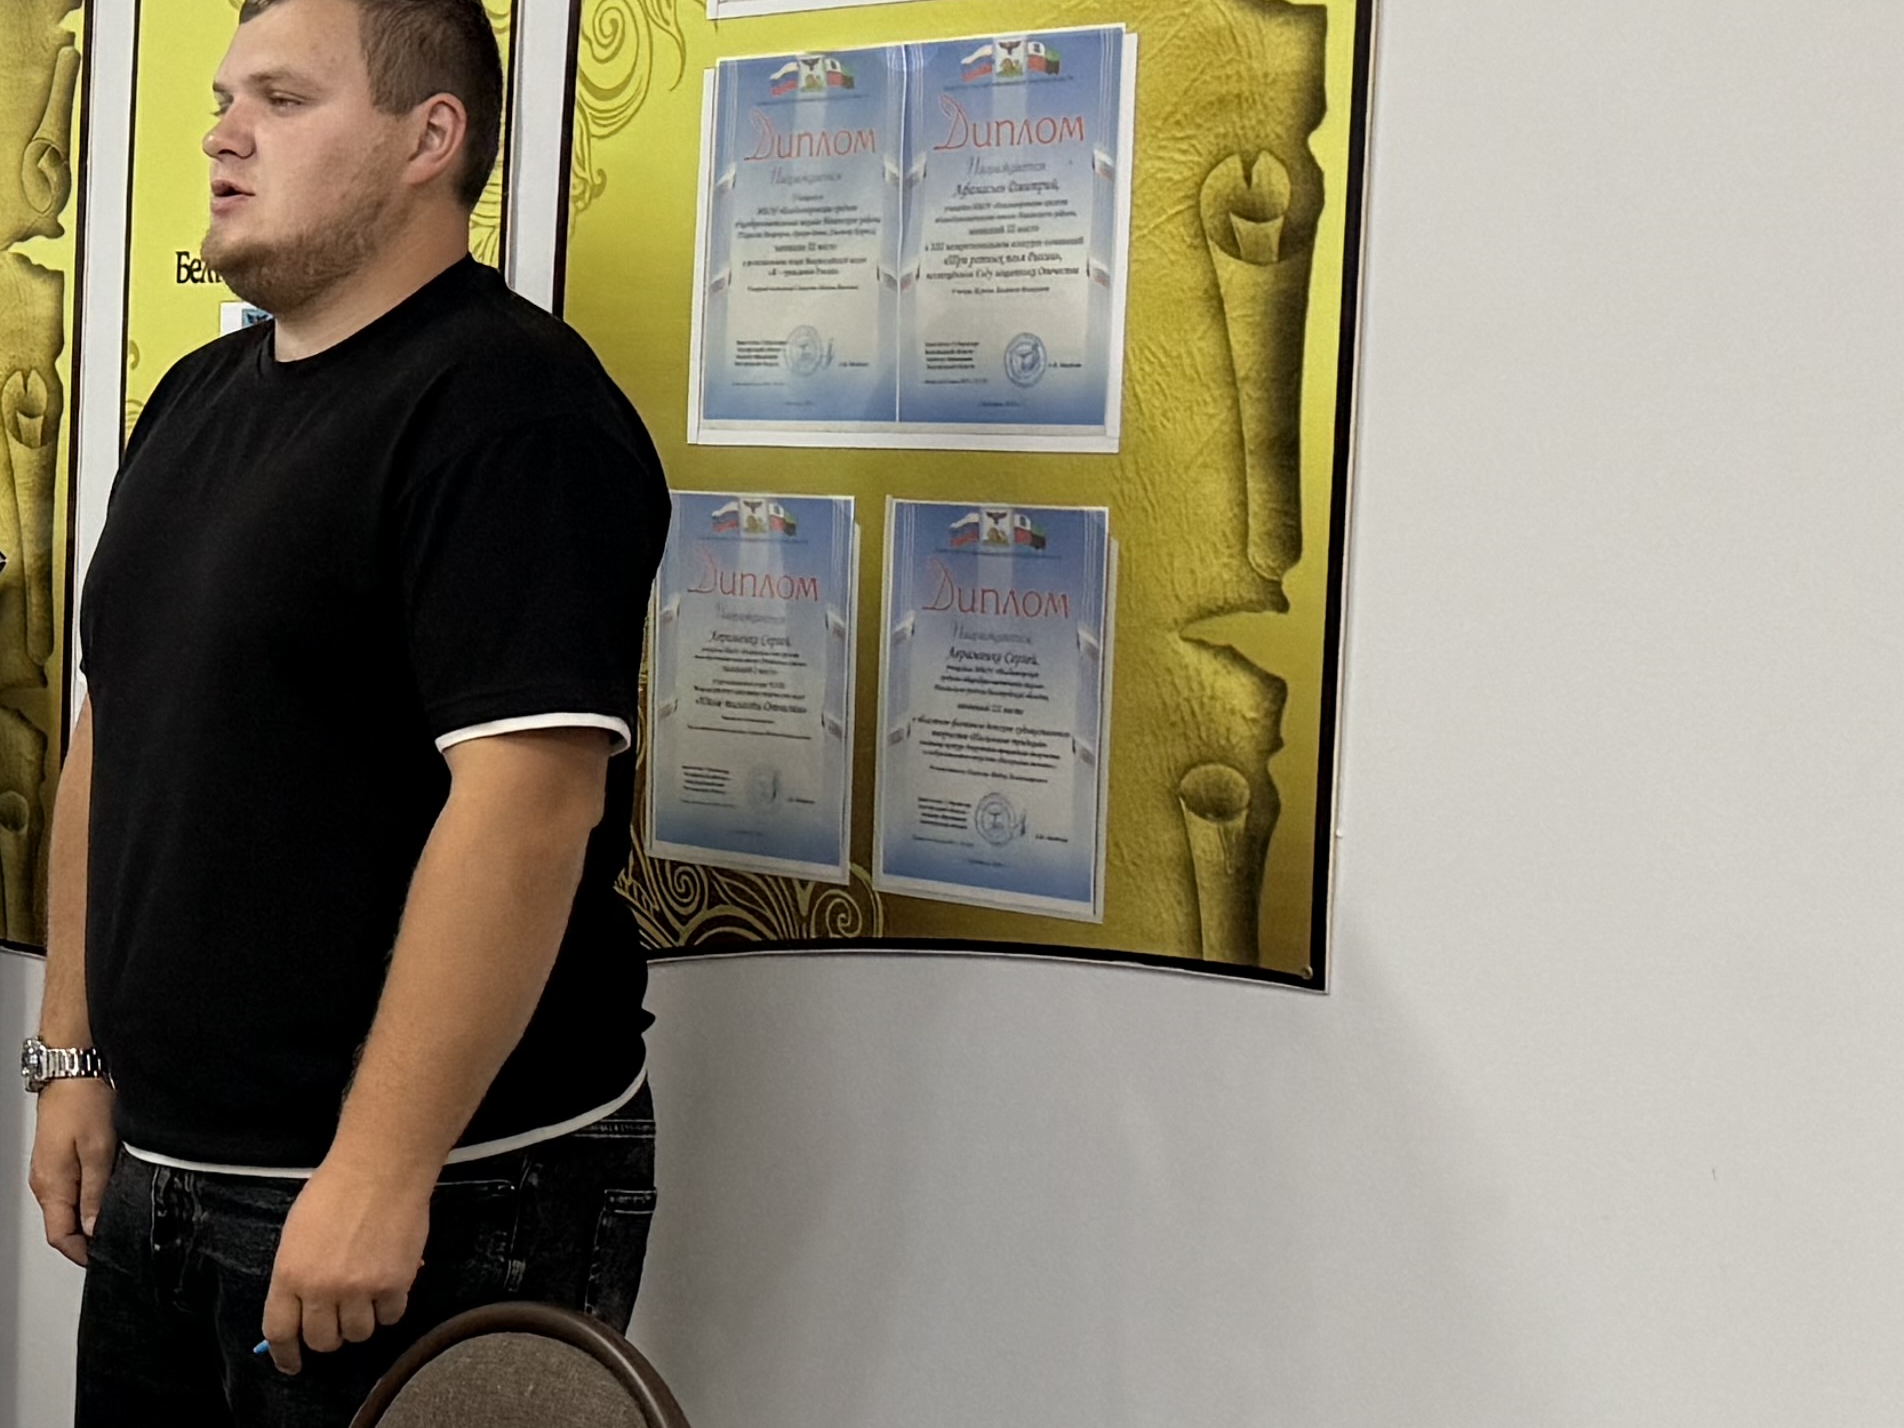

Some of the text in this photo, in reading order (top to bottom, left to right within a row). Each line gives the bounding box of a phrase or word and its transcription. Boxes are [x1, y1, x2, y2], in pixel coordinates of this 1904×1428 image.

[744, 109, 876, 162] Диплом
[933, 93, 1085, 151] Диплом
[922, 558, 1069, 619] Диплом
